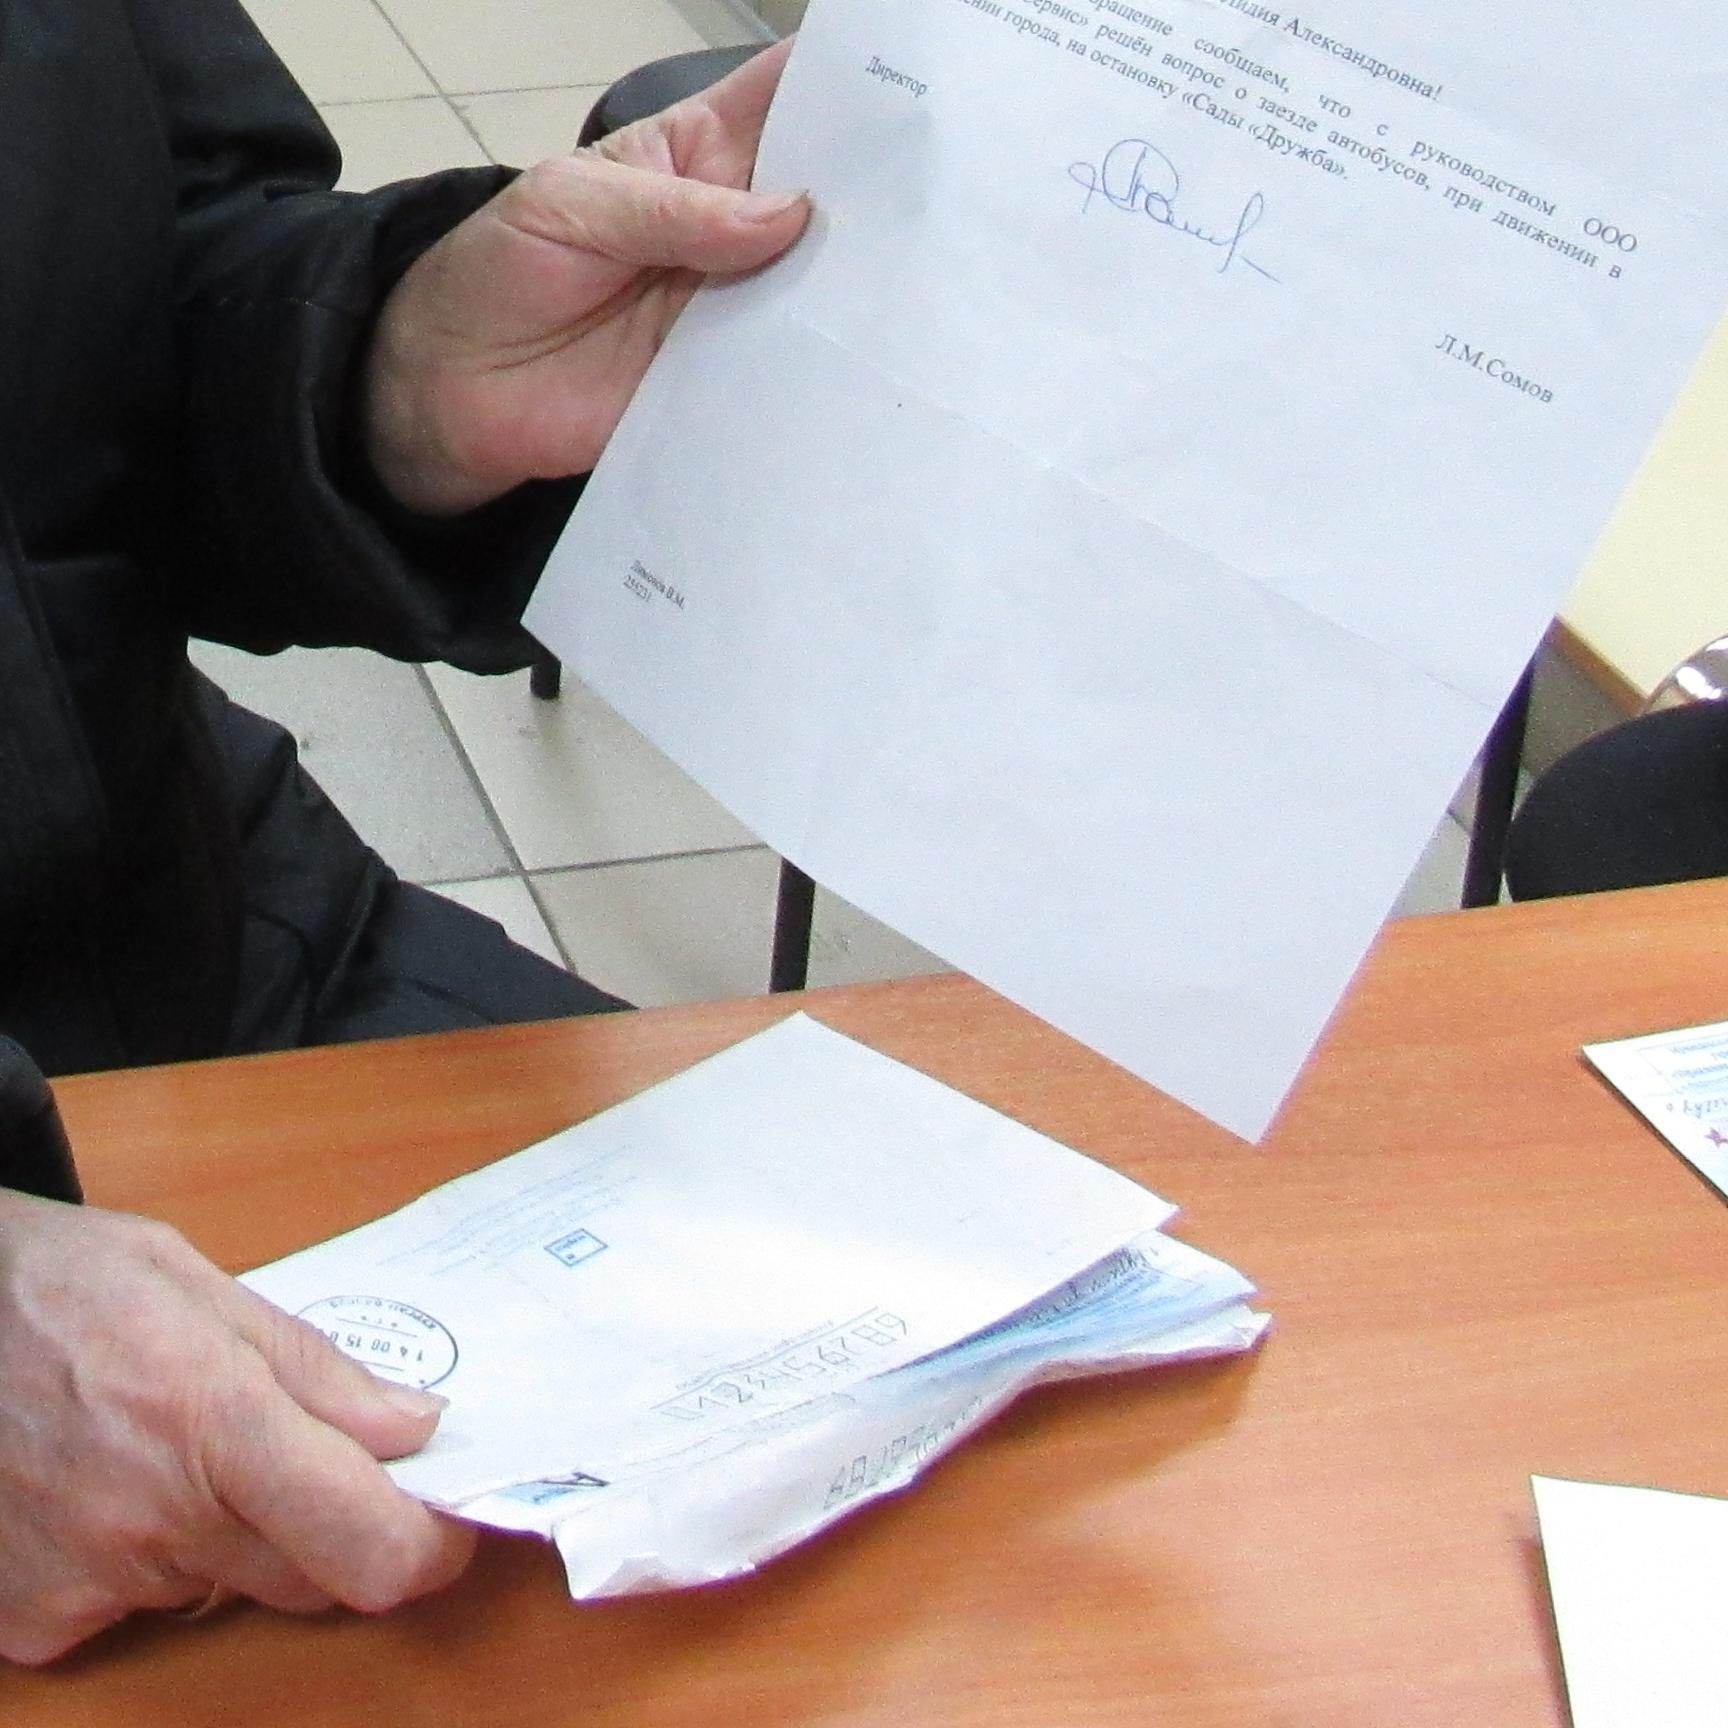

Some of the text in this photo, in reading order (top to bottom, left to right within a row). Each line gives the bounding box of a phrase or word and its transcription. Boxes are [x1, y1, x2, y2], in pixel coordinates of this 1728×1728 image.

[864, 55, 930, 99] Директор
[1004, 10, 1062, 49] города,
[1067, 39, 1087, 58] на
[1089, 49, 1177, 100] остановку
[1182, 90, 1245, 132] «Сады
[1284, 16, 1443, 103] Александровна!
[1095, 21, 1154, 58] решён
[1161, 50, 1226, 93] вопрос
[1234, 85, 1247, 101] о
[1256, 95, 1319, 135] заезде
[1326, 129, 1432, 192] автобусов,
[1443, 185, 1483, 217] при
[1491, 209, 1599, 269] движении
[1607, 263, 1623, 280] в
[1193, 35, 1290, 94] сообщаем,
[1318, 93, 1352, 120] что
[1376, 122, 1390, 137] с
[1410, 139, 1558, 218] руководством
[1583, 216, 1638, 255] ООО
